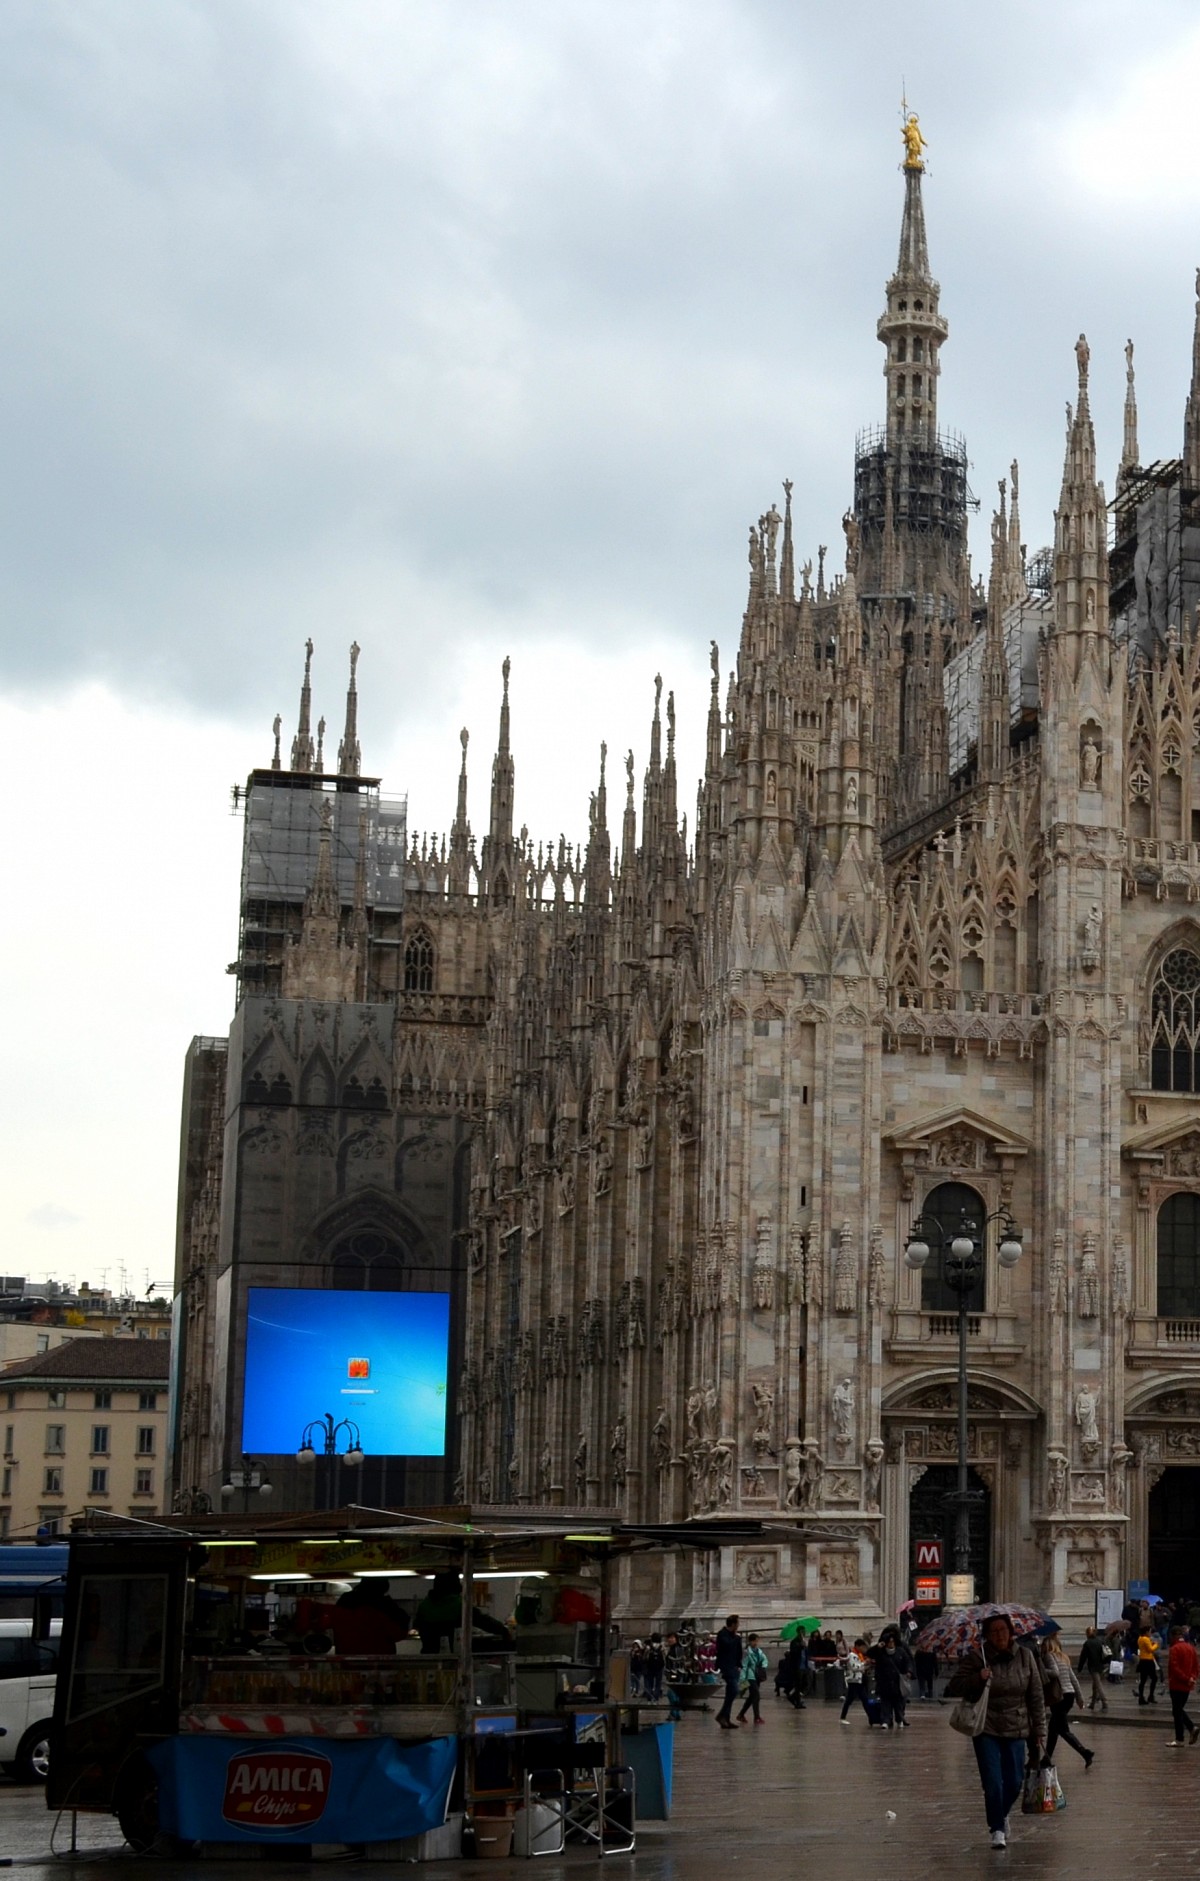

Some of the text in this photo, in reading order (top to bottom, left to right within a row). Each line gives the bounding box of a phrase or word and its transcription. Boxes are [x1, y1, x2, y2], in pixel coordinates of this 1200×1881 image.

[917, 1546, 940, 1564] M
[229, 1763, 325, 1795] AMICA
[253, 1794, 297, 1821] Chips
